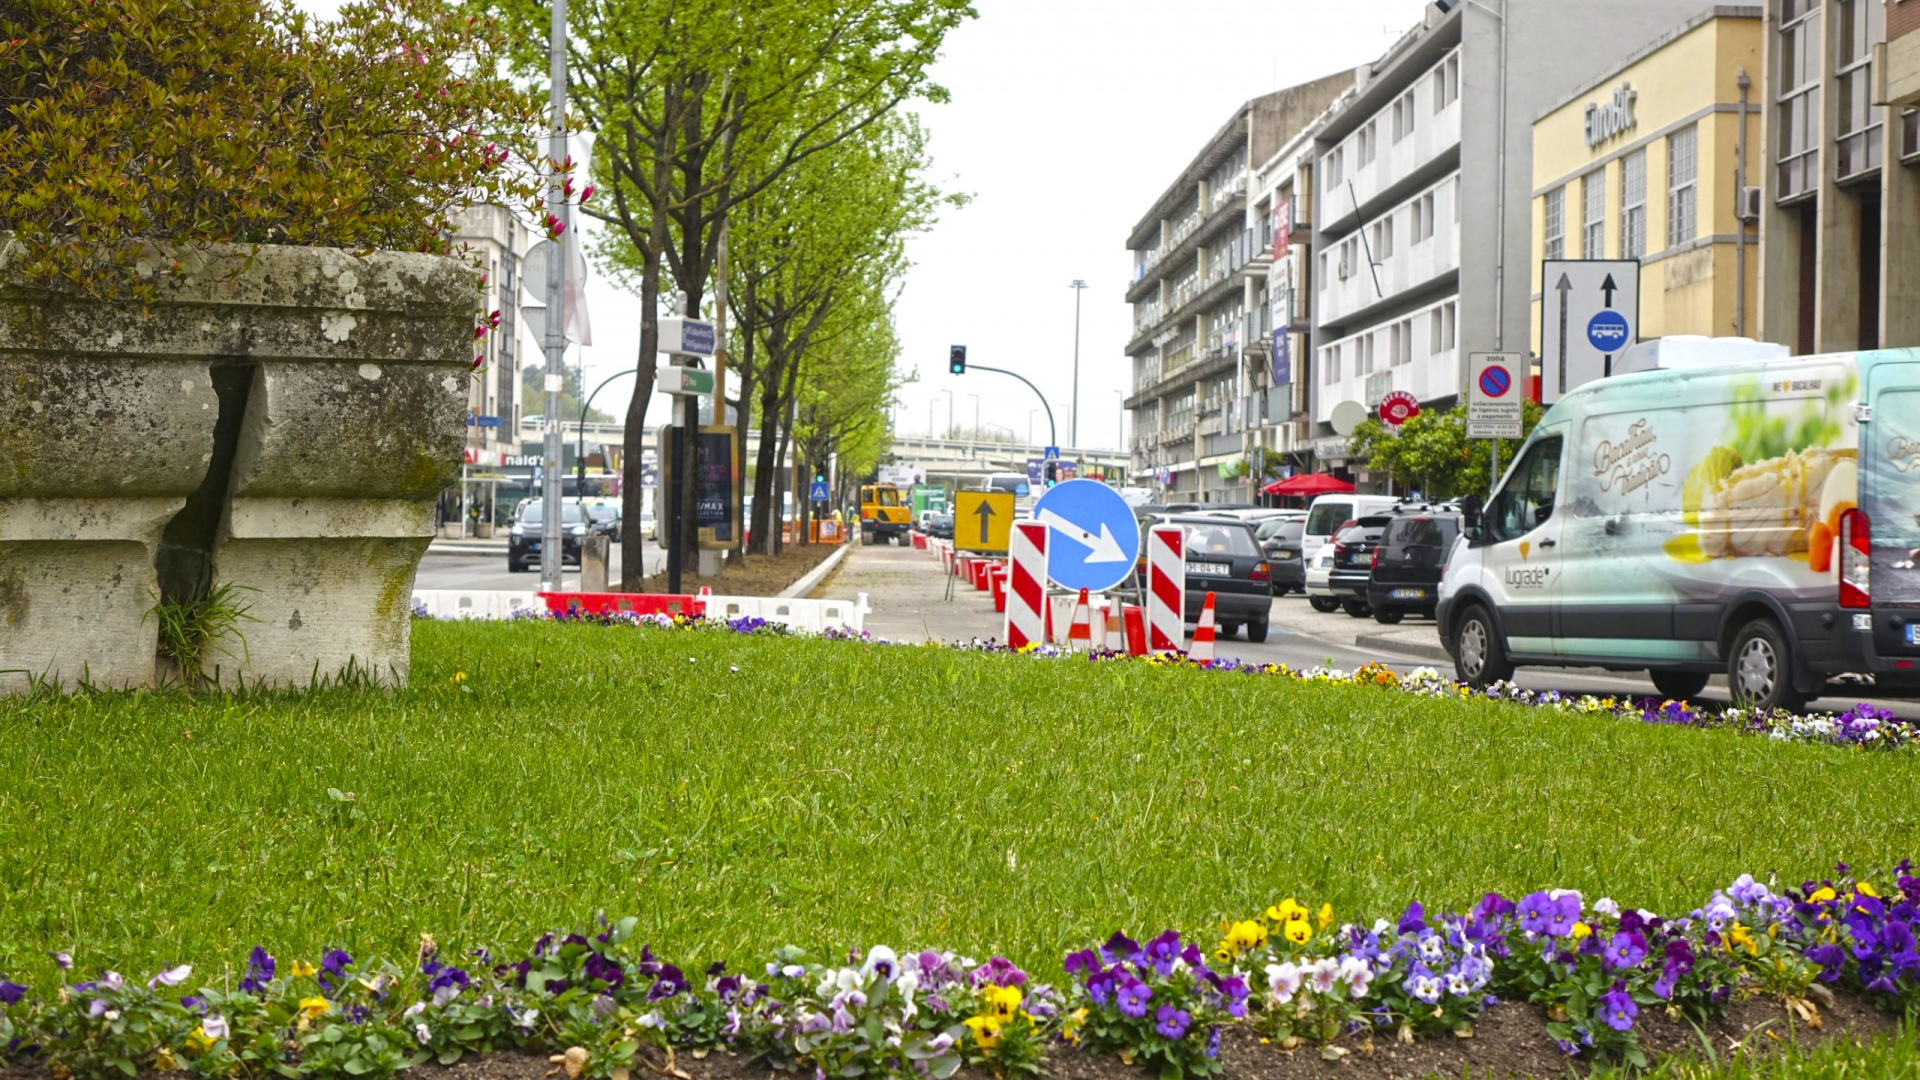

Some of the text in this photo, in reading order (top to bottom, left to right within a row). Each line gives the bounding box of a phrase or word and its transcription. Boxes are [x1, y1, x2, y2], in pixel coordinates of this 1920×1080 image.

[1584, 81, 1637, 147] EuroBic
[1486, 354, 1505, 362] zona
[505, 454, 544, 466] nald's
